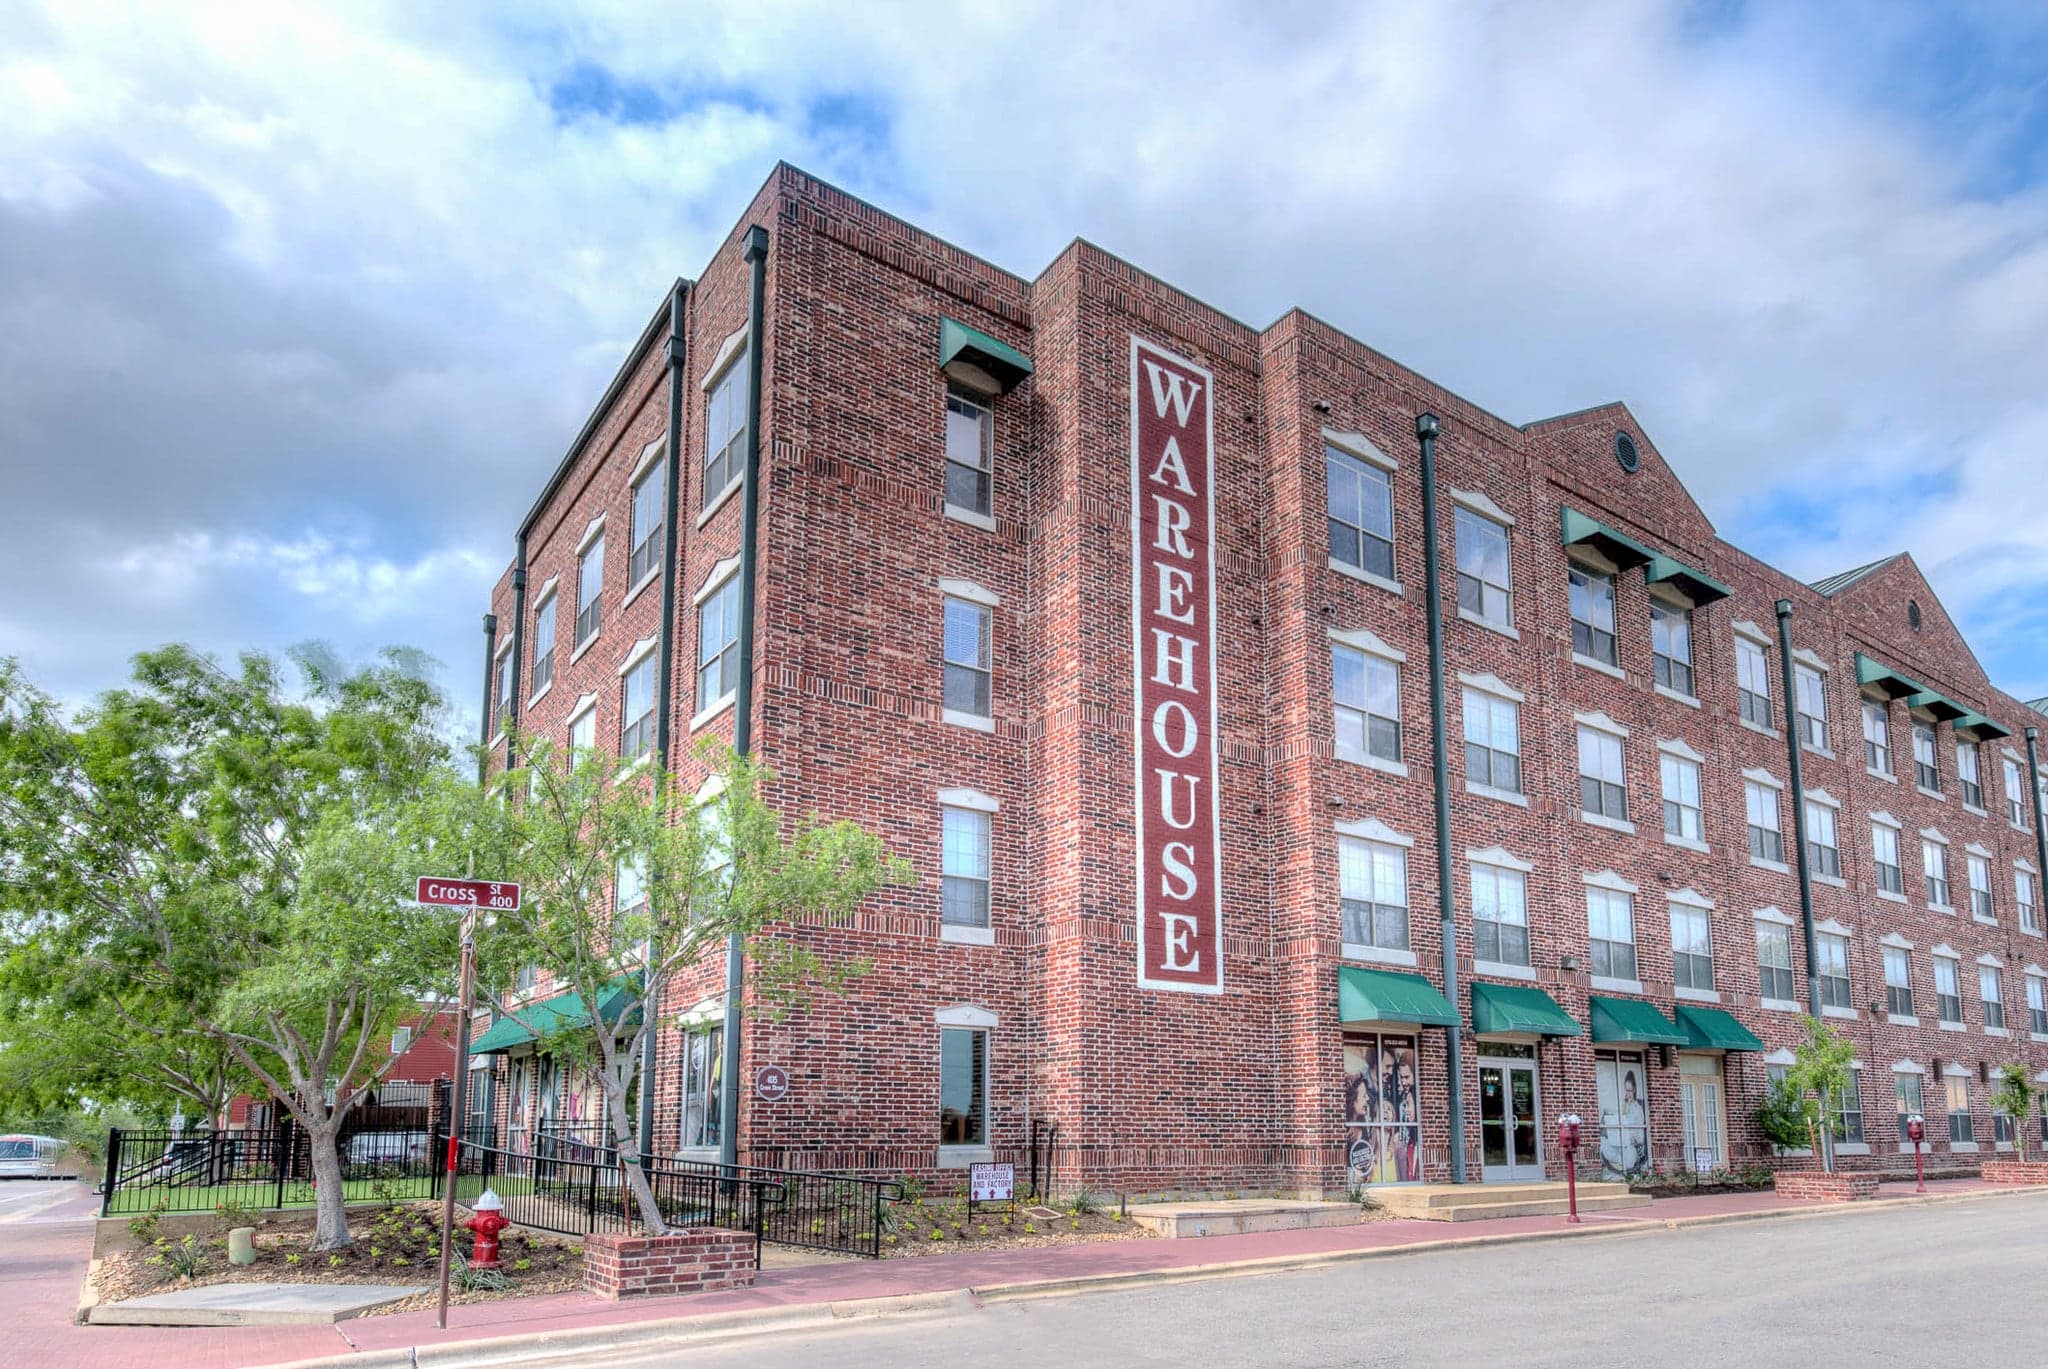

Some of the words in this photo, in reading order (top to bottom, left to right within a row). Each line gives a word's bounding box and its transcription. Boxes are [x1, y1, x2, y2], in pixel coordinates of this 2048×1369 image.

[1141, 358, 1202, 972] WAREHOUSE
[428, 884, 476, 901] Cross
[490, 884, 502, 895] St
[490, 896, 513, 908] 400
[976, 1171, 1009, 1179] WAREHOUSE
[987, 1180, 1011, 1188] FACTORY
